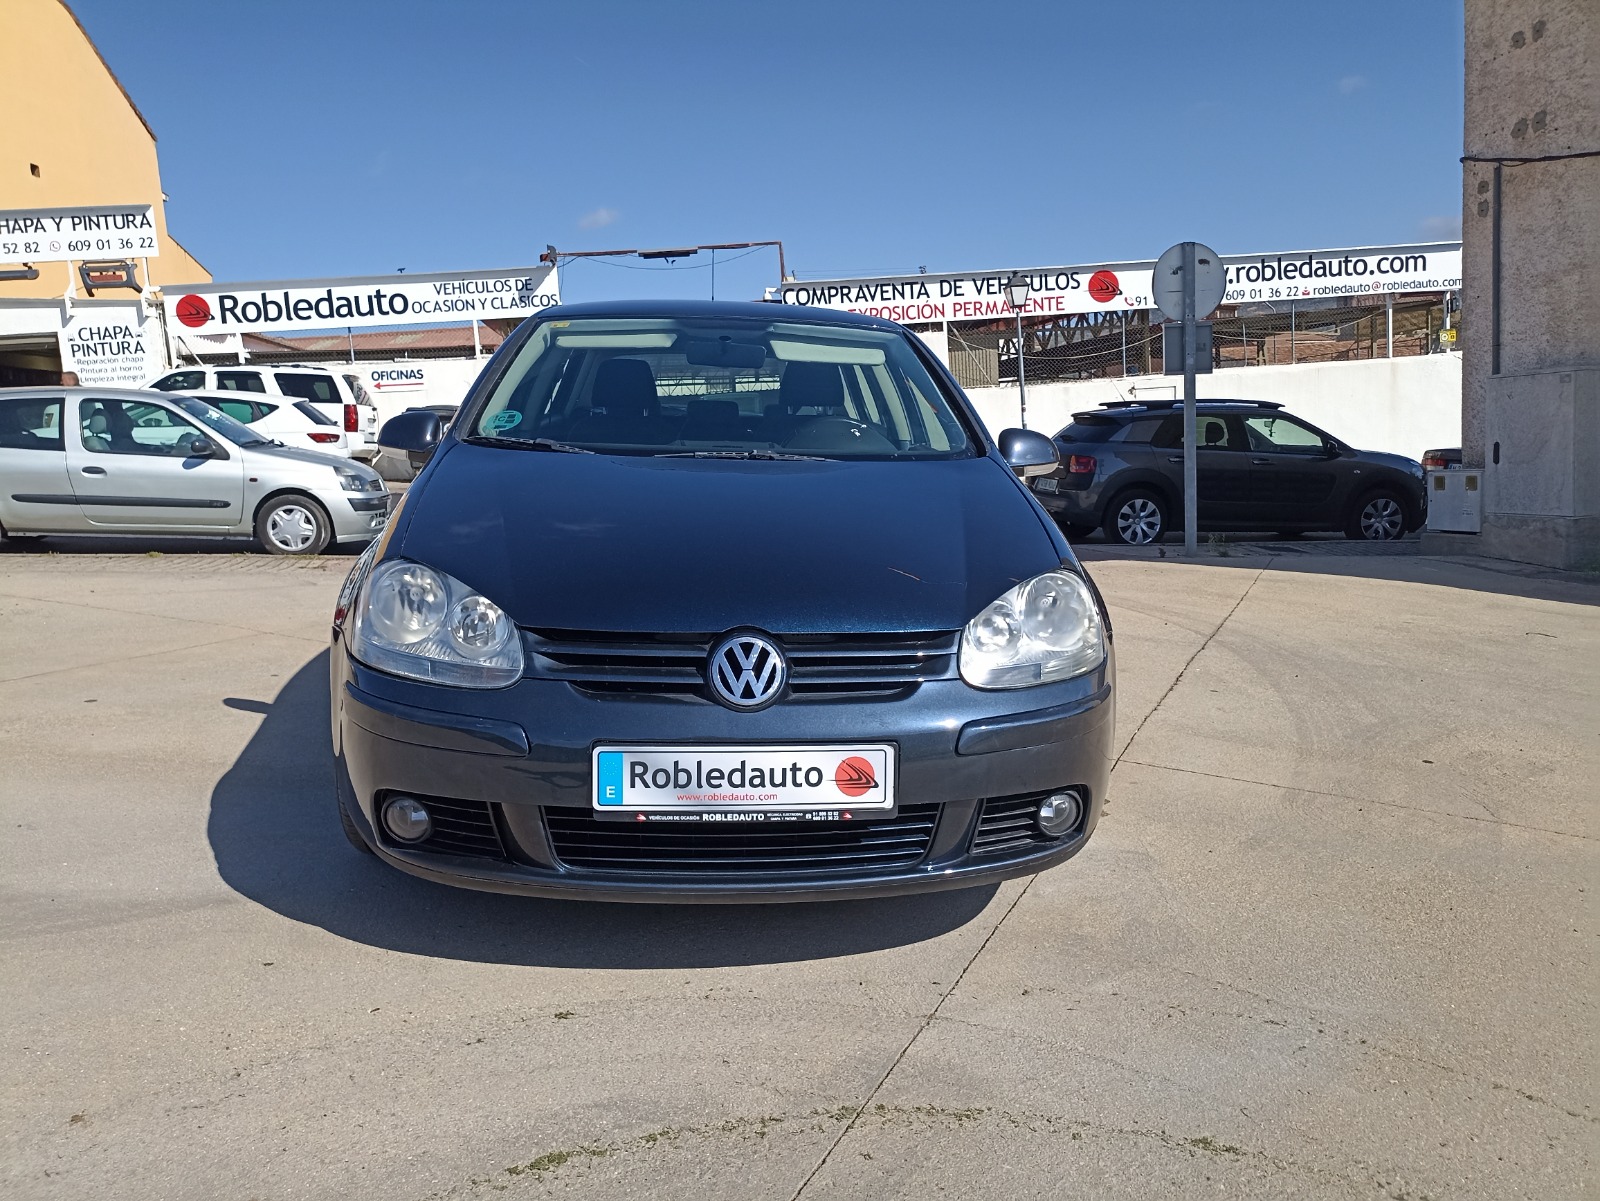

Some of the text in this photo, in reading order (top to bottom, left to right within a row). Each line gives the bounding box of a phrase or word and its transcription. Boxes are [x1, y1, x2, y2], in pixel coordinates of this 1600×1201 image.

[50, 216, 63, 232] Y
[71, 213, 152, 231] PINTURA
[3, 237, 155, 254] 52 82 609 01 36 22
[433, 278, 534, 296] VEHÍCULOS DE
[783, 271, 1081, 306] COMPRAVENTA DE VEHULOS
[1225, 289, 1245, 301] 609
[1250, 288, 1262, 299] 01
[1268, 288, 1281, 298] 36
[1286, 286, 1299, 297] 22
[218, 288, 409, 325] Robledauto
[411, 292, 559, 314] OCASIÓN Y CLÁSICOS
[1135, 296, 1148, 306] 91
[78, 325, 134, 342] CHAPA
[71, 340, 146, 358] PINTURA
[121, 356, 144, 364] chapa
[117, 373, 146, 382] integral
[371, 369, 424, 381] OFICINAS
[629, 760, 823, 789] Robledauto
[606, 786, 615, 798] E
[677, 793, 777, 801] www.robledauto.com
[702, 813, 764, 821] ROBLEDAUTO
